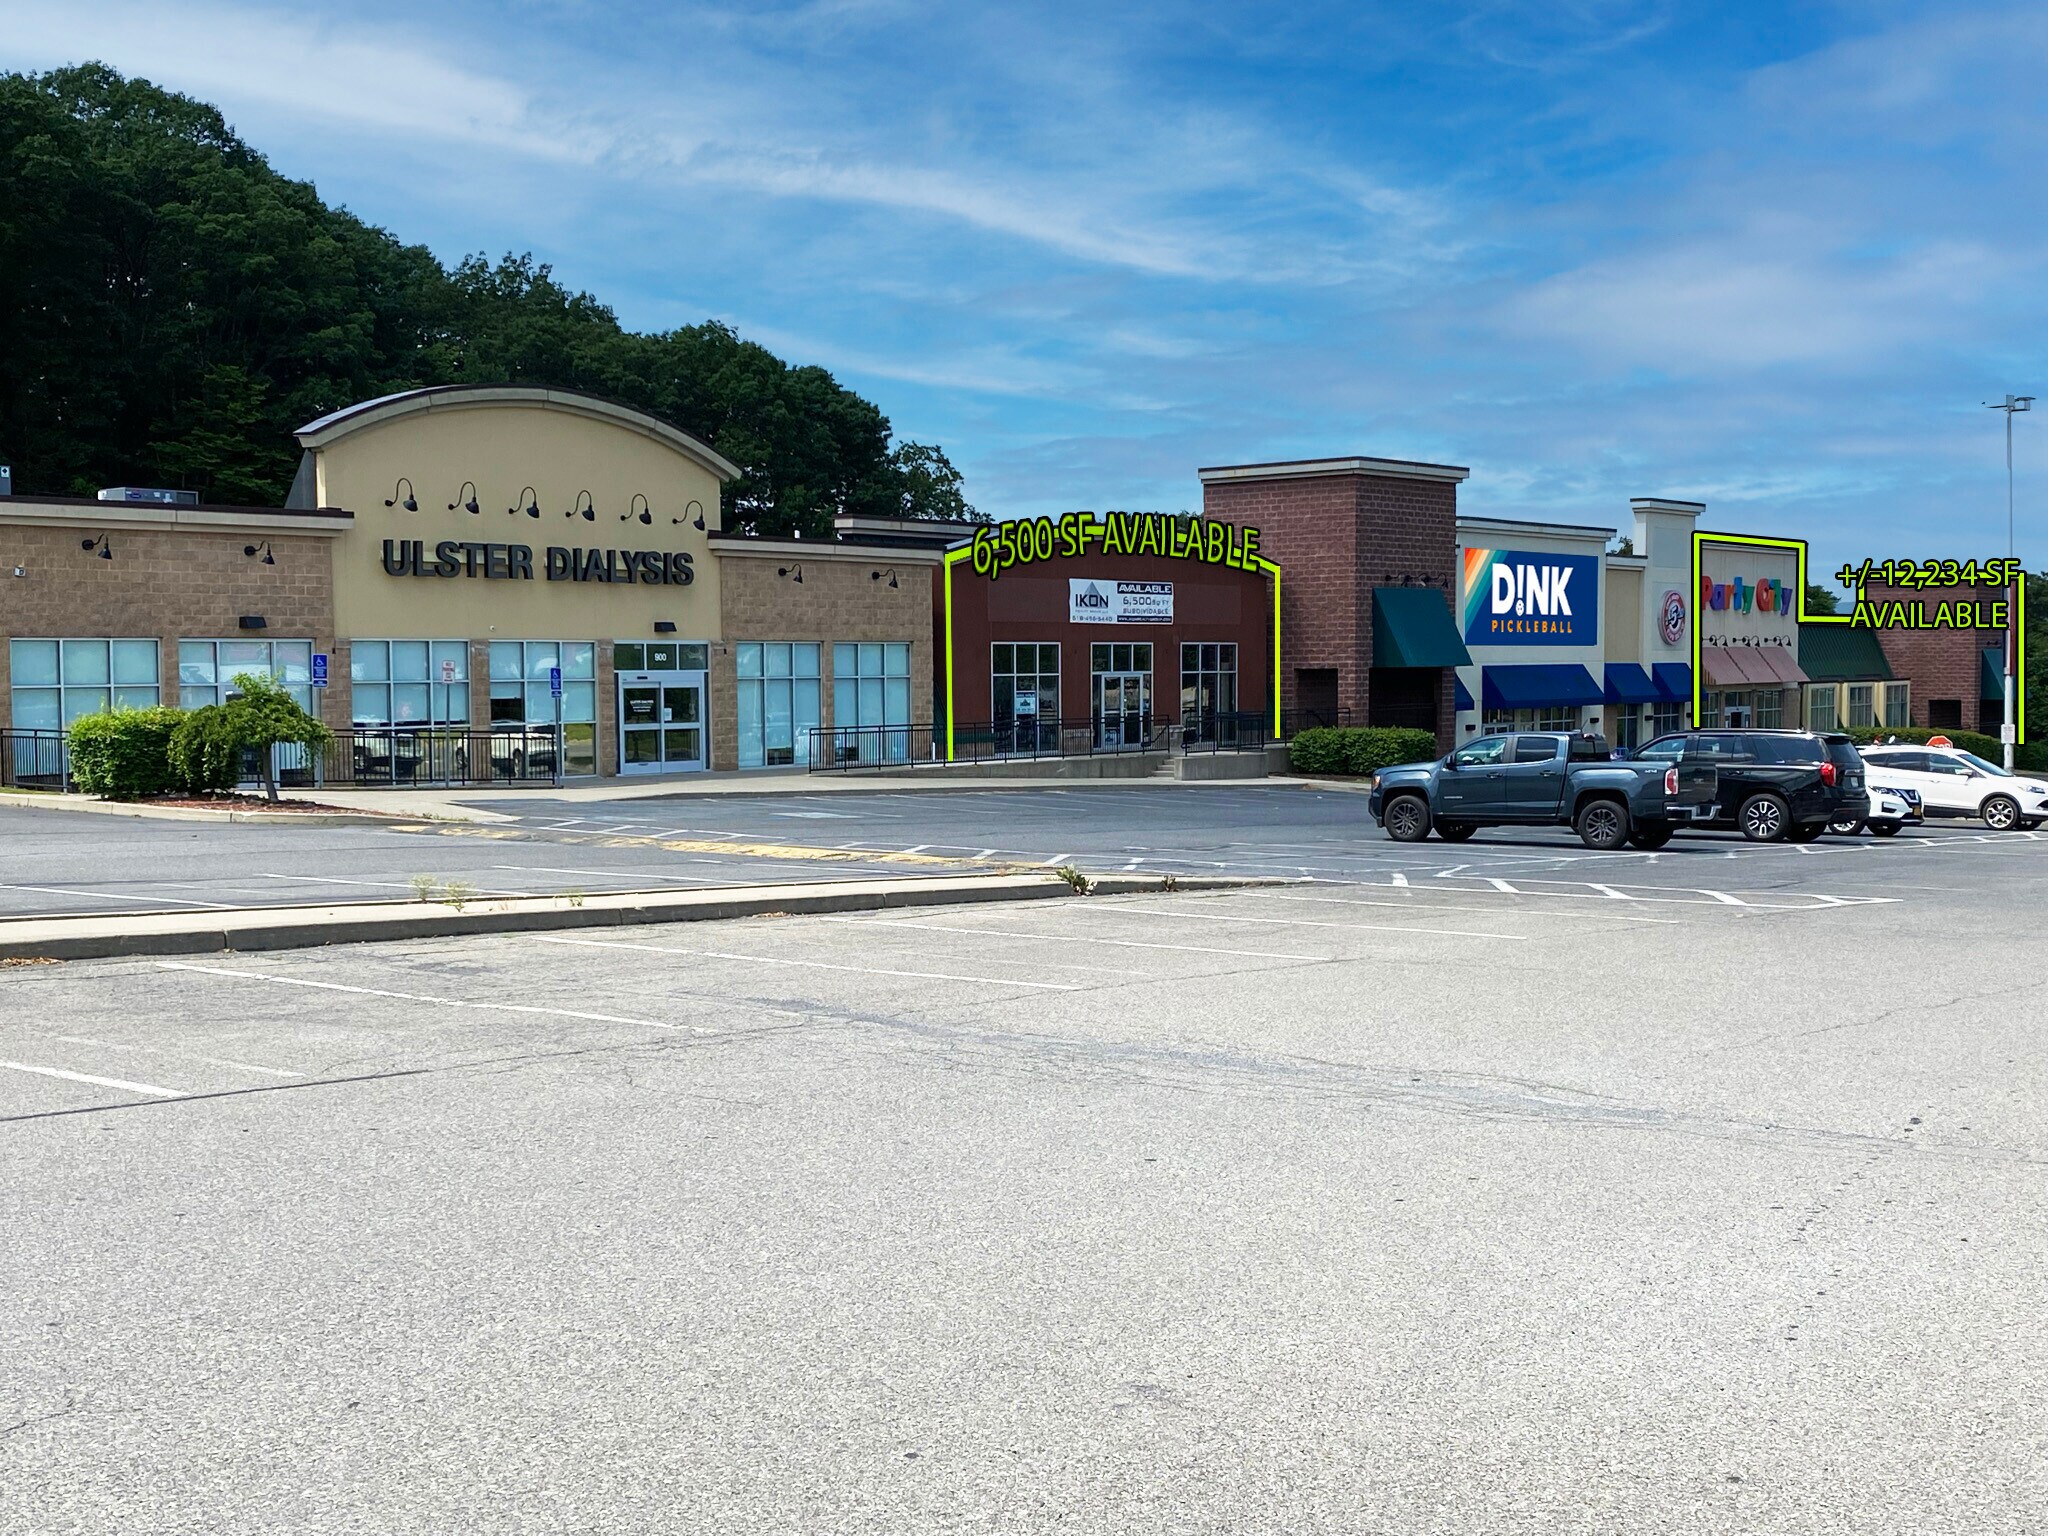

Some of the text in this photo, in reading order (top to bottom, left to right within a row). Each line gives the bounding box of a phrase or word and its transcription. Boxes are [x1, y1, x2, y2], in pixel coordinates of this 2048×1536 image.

[383, 539, 695, 585] ULSTER DIALYSIS
[1118, 584, 1172, 594] AVAILABLE
[1702, 575, 1794, 617] Party City
[1075, 593, 1109, 608] IKON
[1122, 596, 1152, 606] 6,500
[1491, 619, 1573, 633] PICKLEBALL
[654, 652, 667, 661] 900
